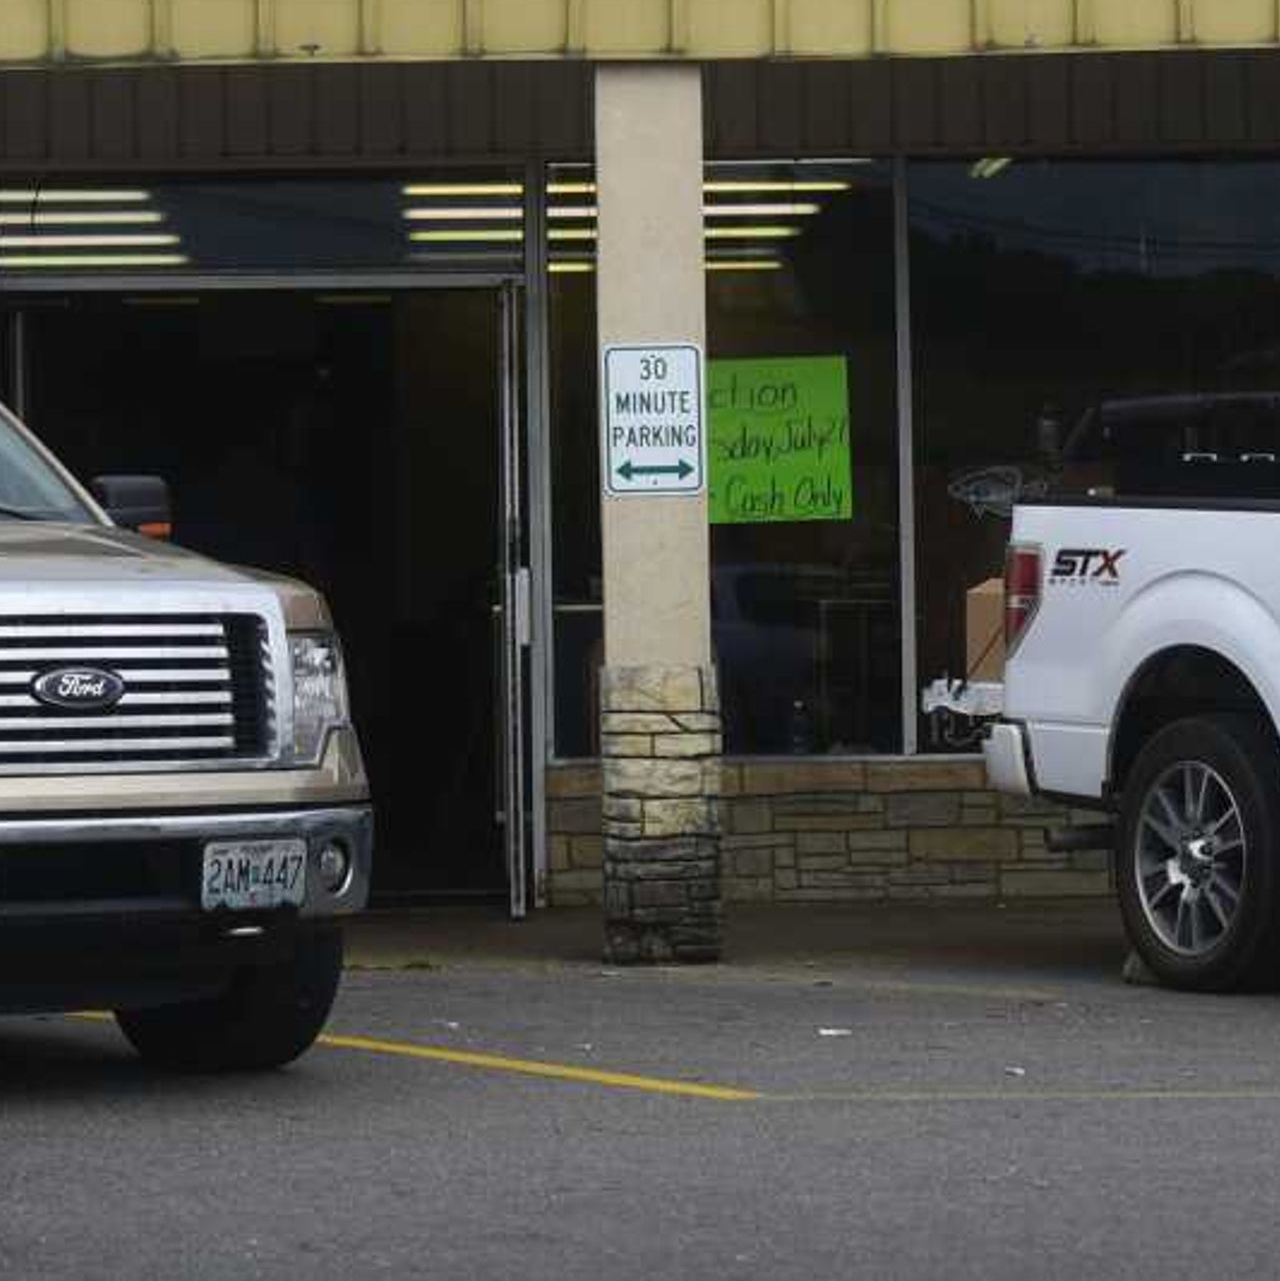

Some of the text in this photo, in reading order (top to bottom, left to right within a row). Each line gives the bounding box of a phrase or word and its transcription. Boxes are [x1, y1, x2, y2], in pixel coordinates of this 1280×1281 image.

[639, 357, 667, 380] 30
[615, 390, 690, 414] MINUTE
[708, 373, 798, 410] ction
[612, 424, 697, 448] PARKING
[793, 475, 842, 513] Only
[1051, 549, 1126, 578] STX
[57, 673, 107, 697] Ford
